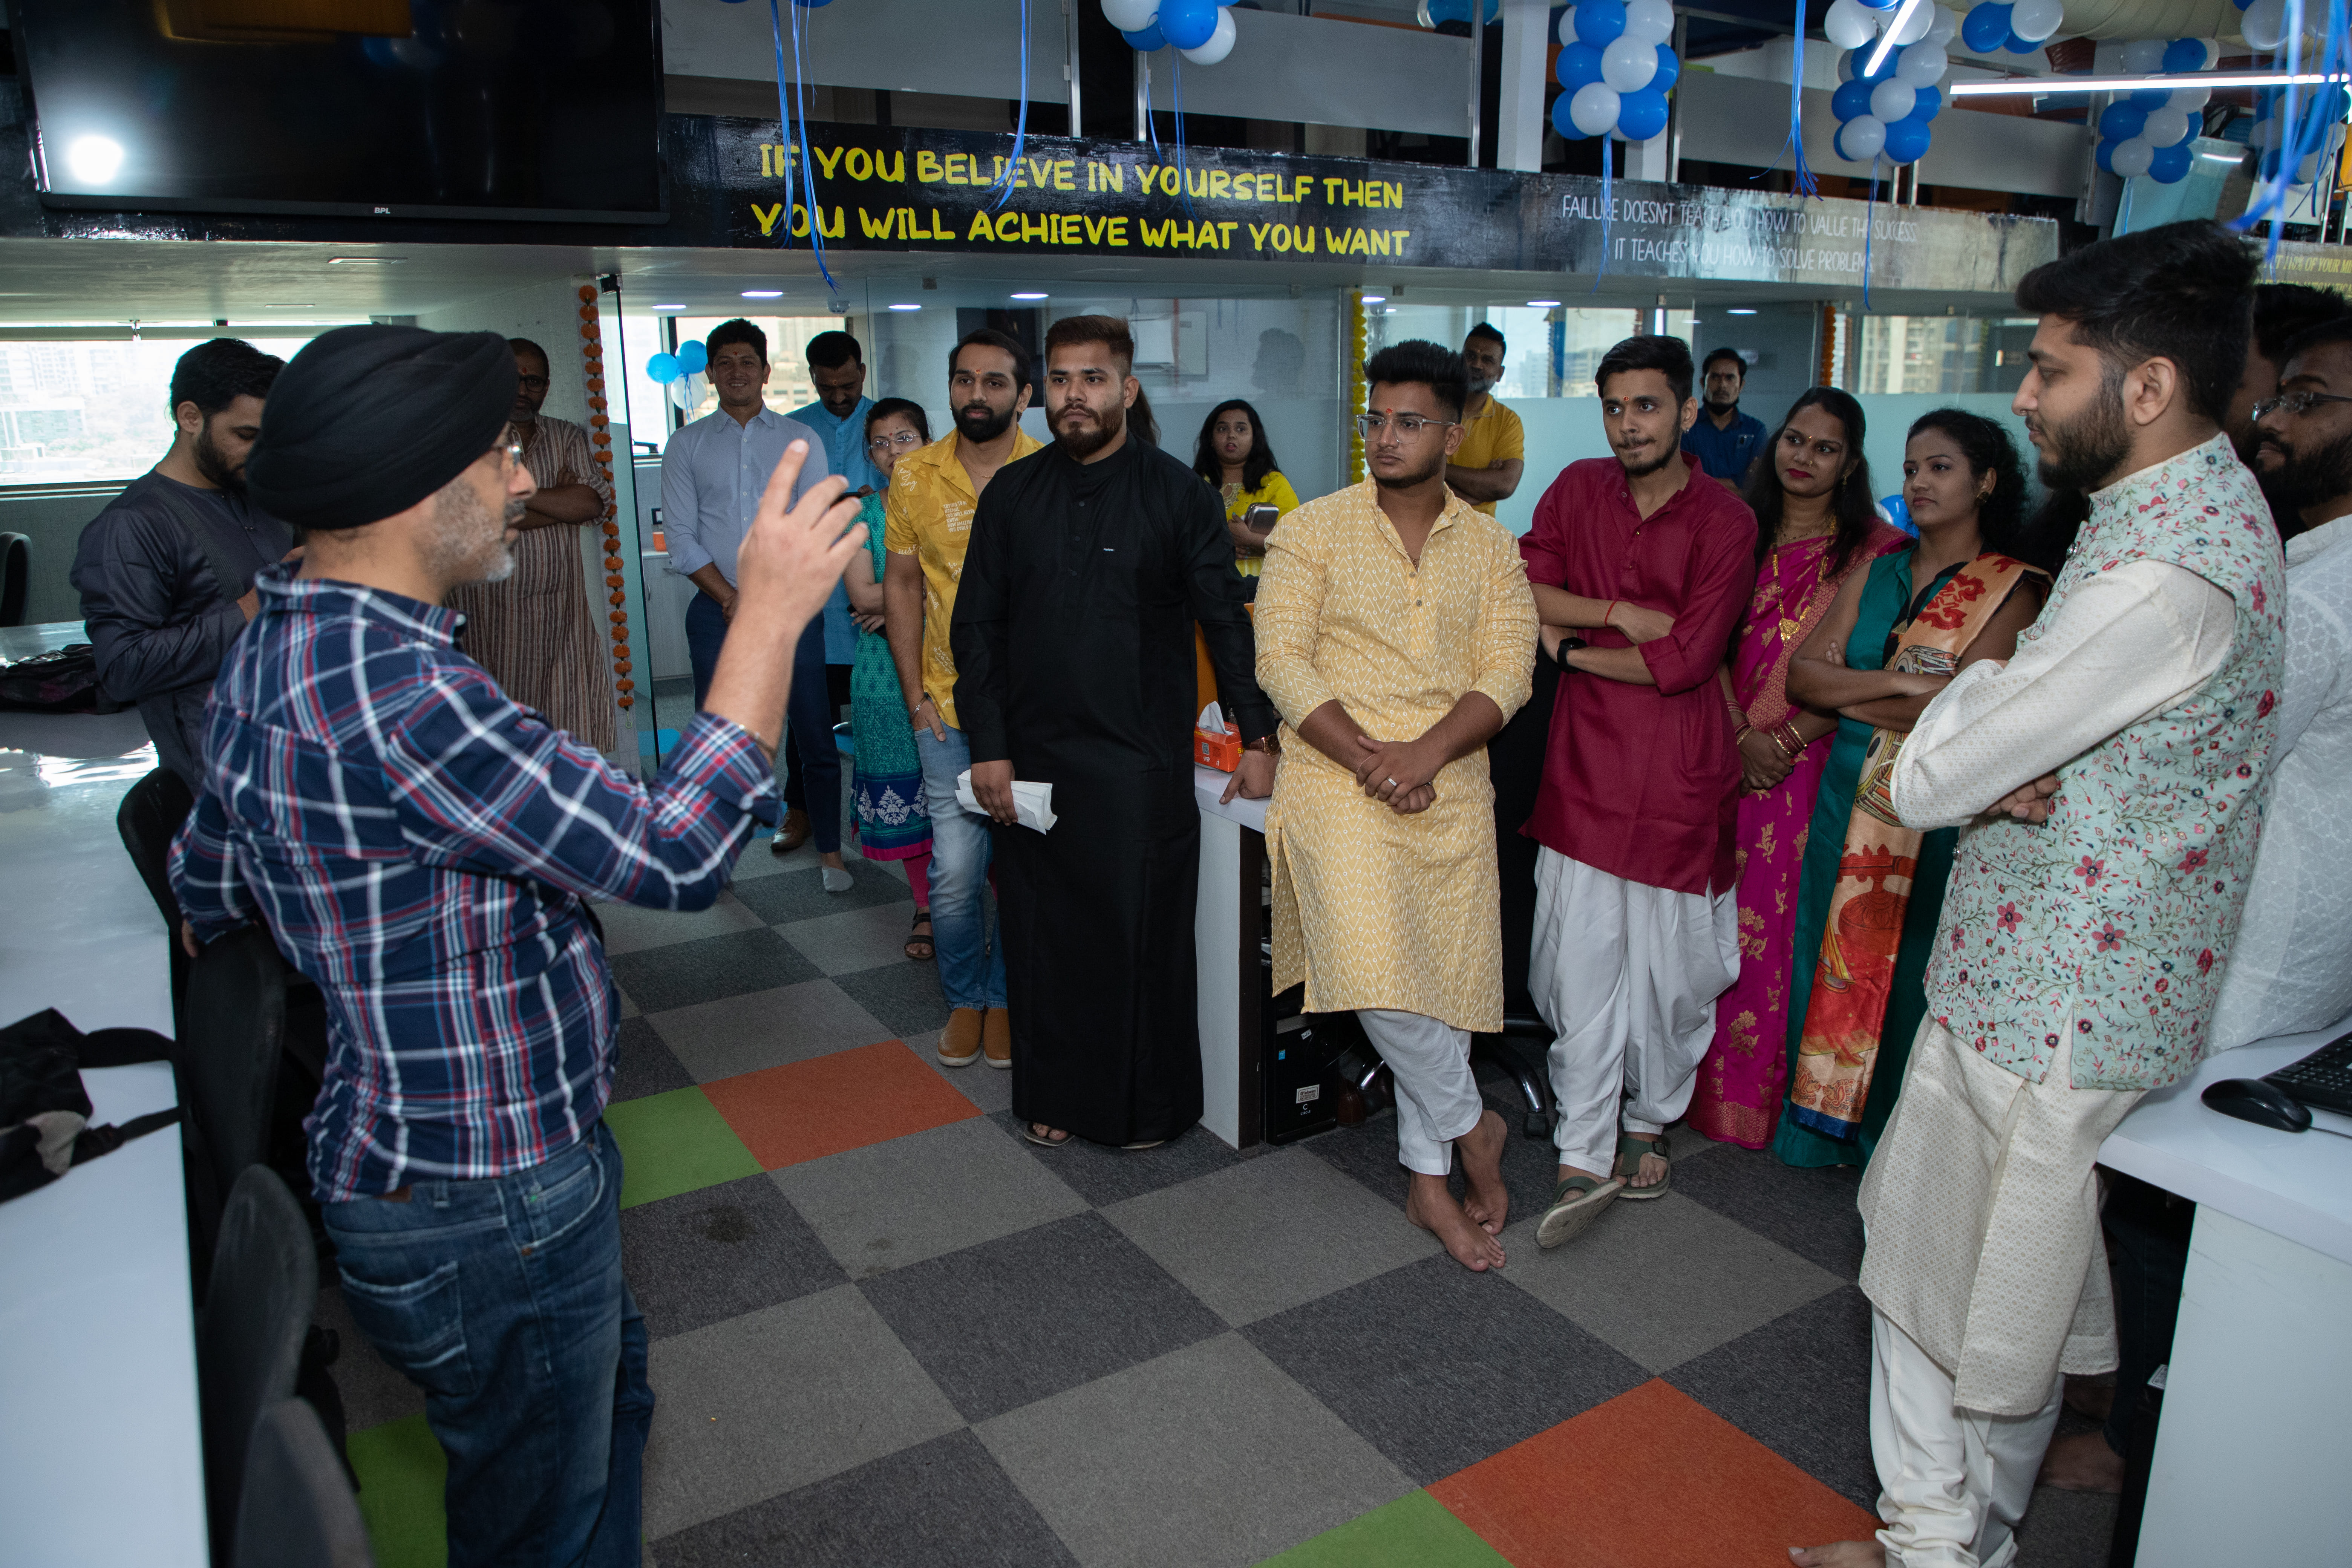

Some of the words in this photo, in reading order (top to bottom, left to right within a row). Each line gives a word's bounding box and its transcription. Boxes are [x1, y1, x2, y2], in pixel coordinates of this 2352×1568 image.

[760, 144, 800, 178] IF
[814, 147, 905, 182] YOU
[917, 150, 1075, 190] BELIEVE
[1087, 161, 1123, 193] IN
[1135, 165, 1314, 203] YOURSELF
[1323, 177, 1403, 209] THEN
[751, 203, 845, 238] YOU
[859, 207, 956, 240] WILL
[968, 210, 1128, 246] ACHIEVE
[1139, 218, 1238, 250] WHAT
[1248, 223, 1315, 253] YOU
[1325, 227, 1410, 256] WANT
[1756, 210, 1789, 232] HOW
[1793, 212, 1806, 234] TO
[1811, 214, 1848, 237] VALUE
[1614, 237, 1626, 260] IT
[1631, 239, 1687, 263] TEACHES
[1723, 245, 1757, 266] HOW
[1762, 246, 1776, 267] TO
[1779, 247, 1815, 270] SOLVE
